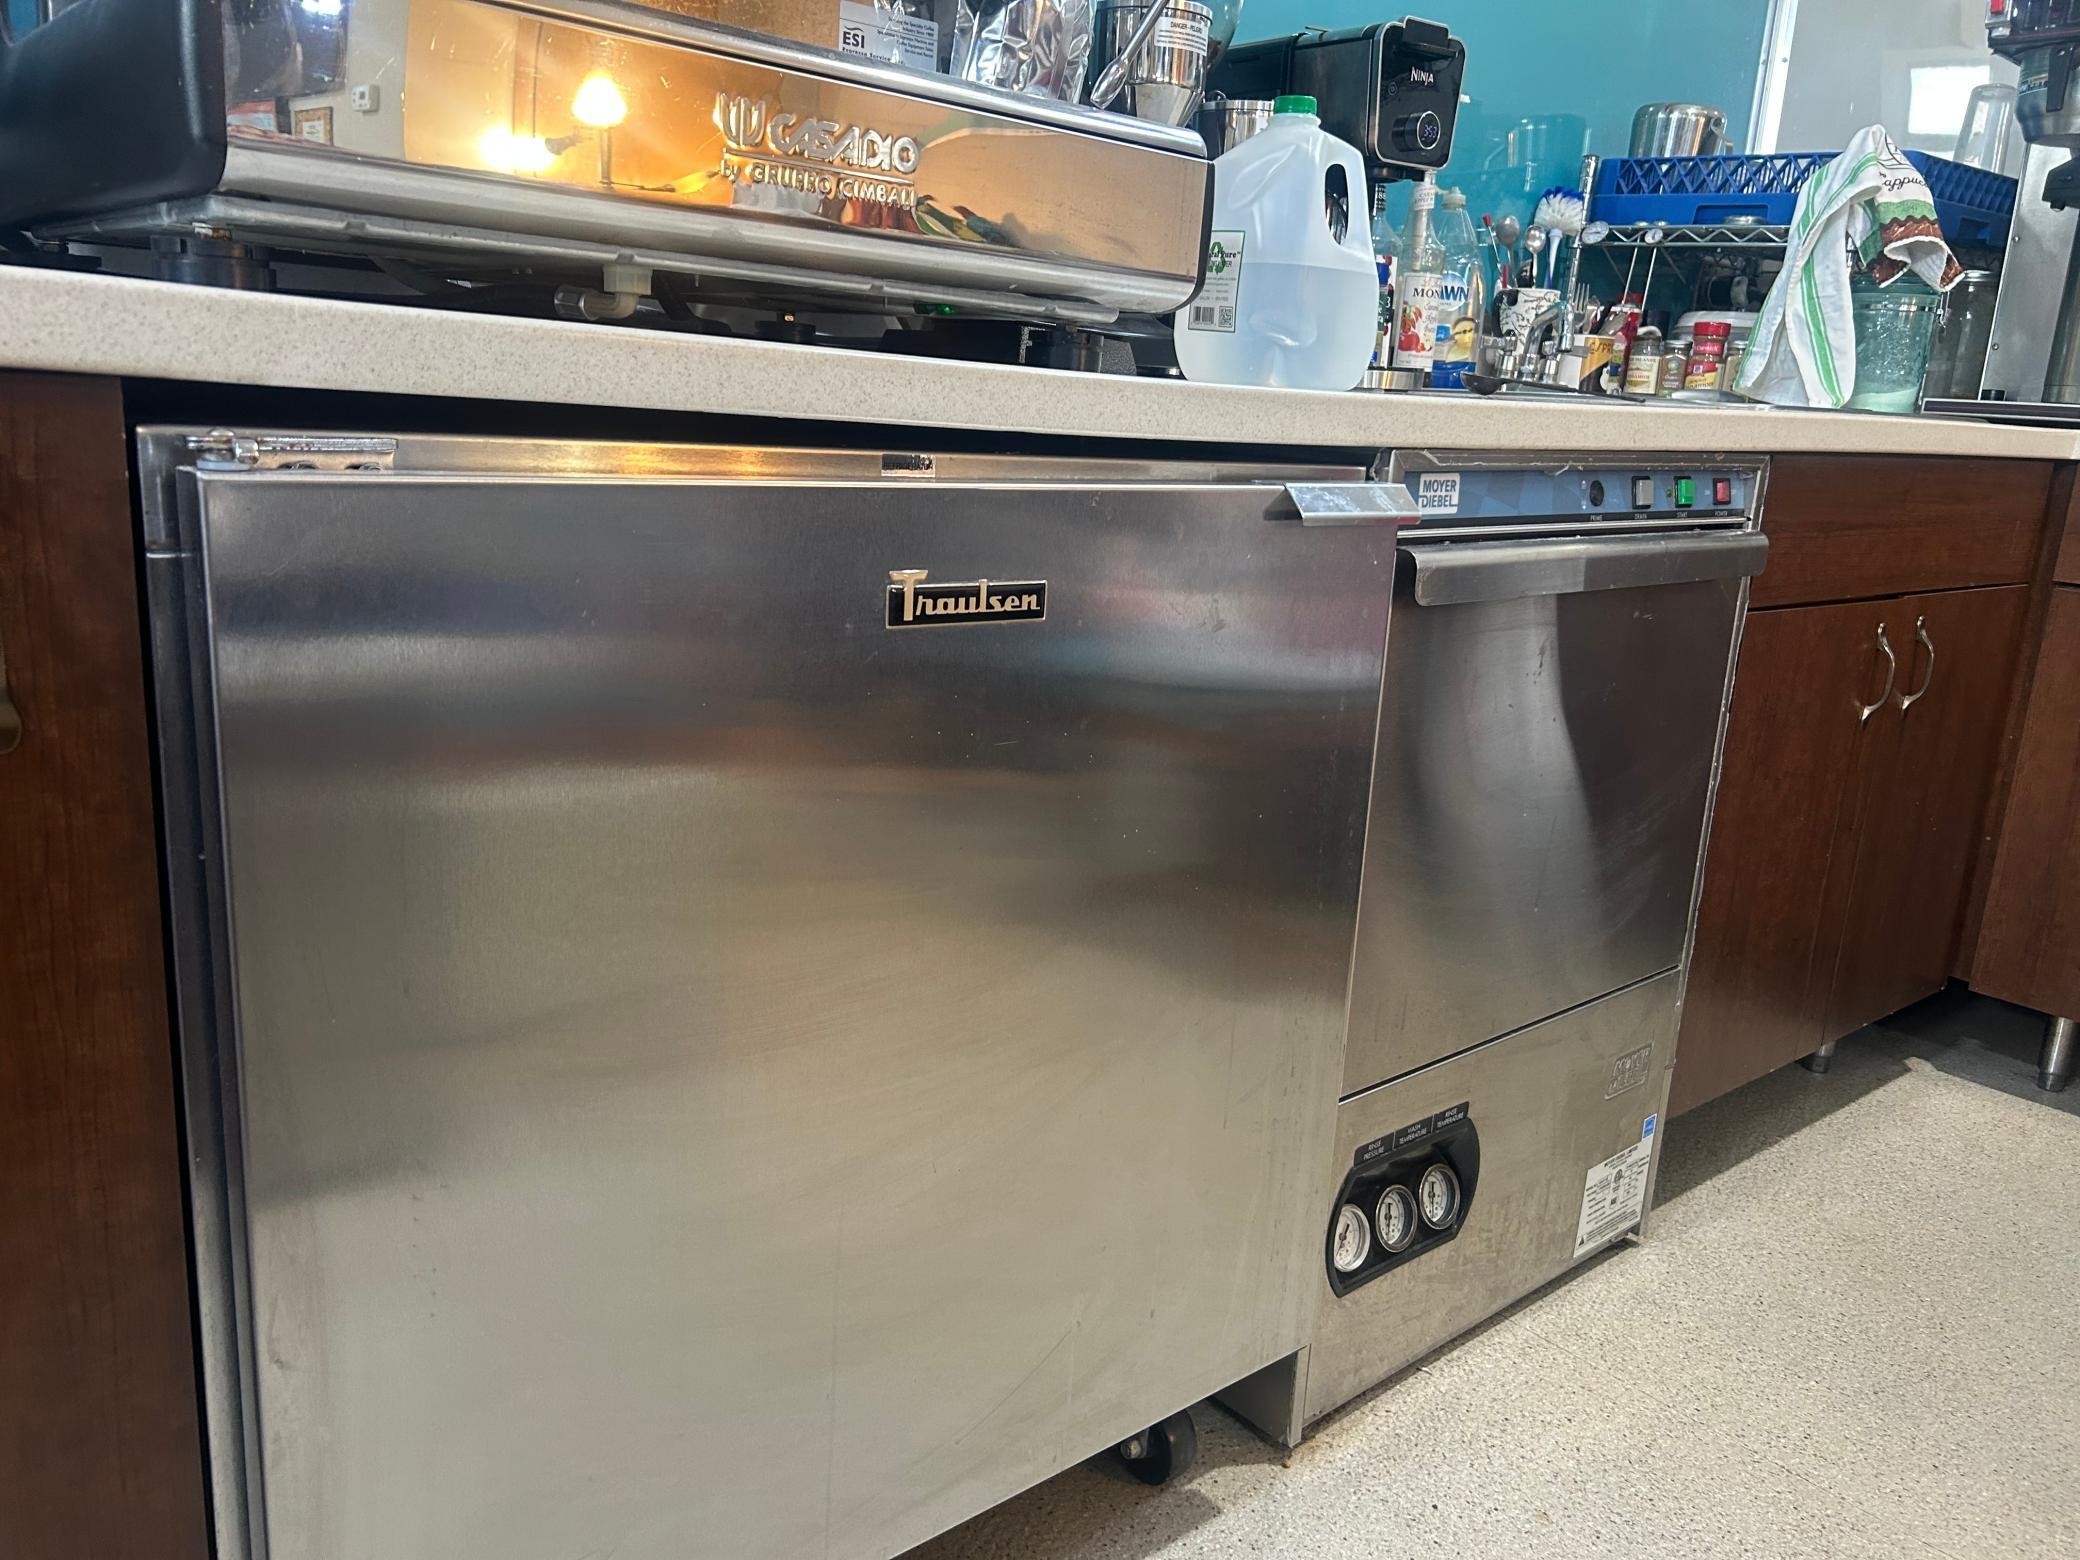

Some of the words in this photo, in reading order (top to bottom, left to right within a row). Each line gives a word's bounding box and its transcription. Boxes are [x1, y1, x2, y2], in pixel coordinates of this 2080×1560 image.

[842, 30, 866, 49] ESI
[766, 112, 920, 174] CASADIO
[719, 158, 741, 183] by
[837, 177, 917, 211] CIMBALI
[1412, 286, 1441, 299] MON
[1422, 479, 1457, 493] MOYER
[1419, 494, 1458, 508] DIEBEL
[889, 569, 1040, 621] Traulsen
[1363, 1146, 1384, 1160] PRESSURE
